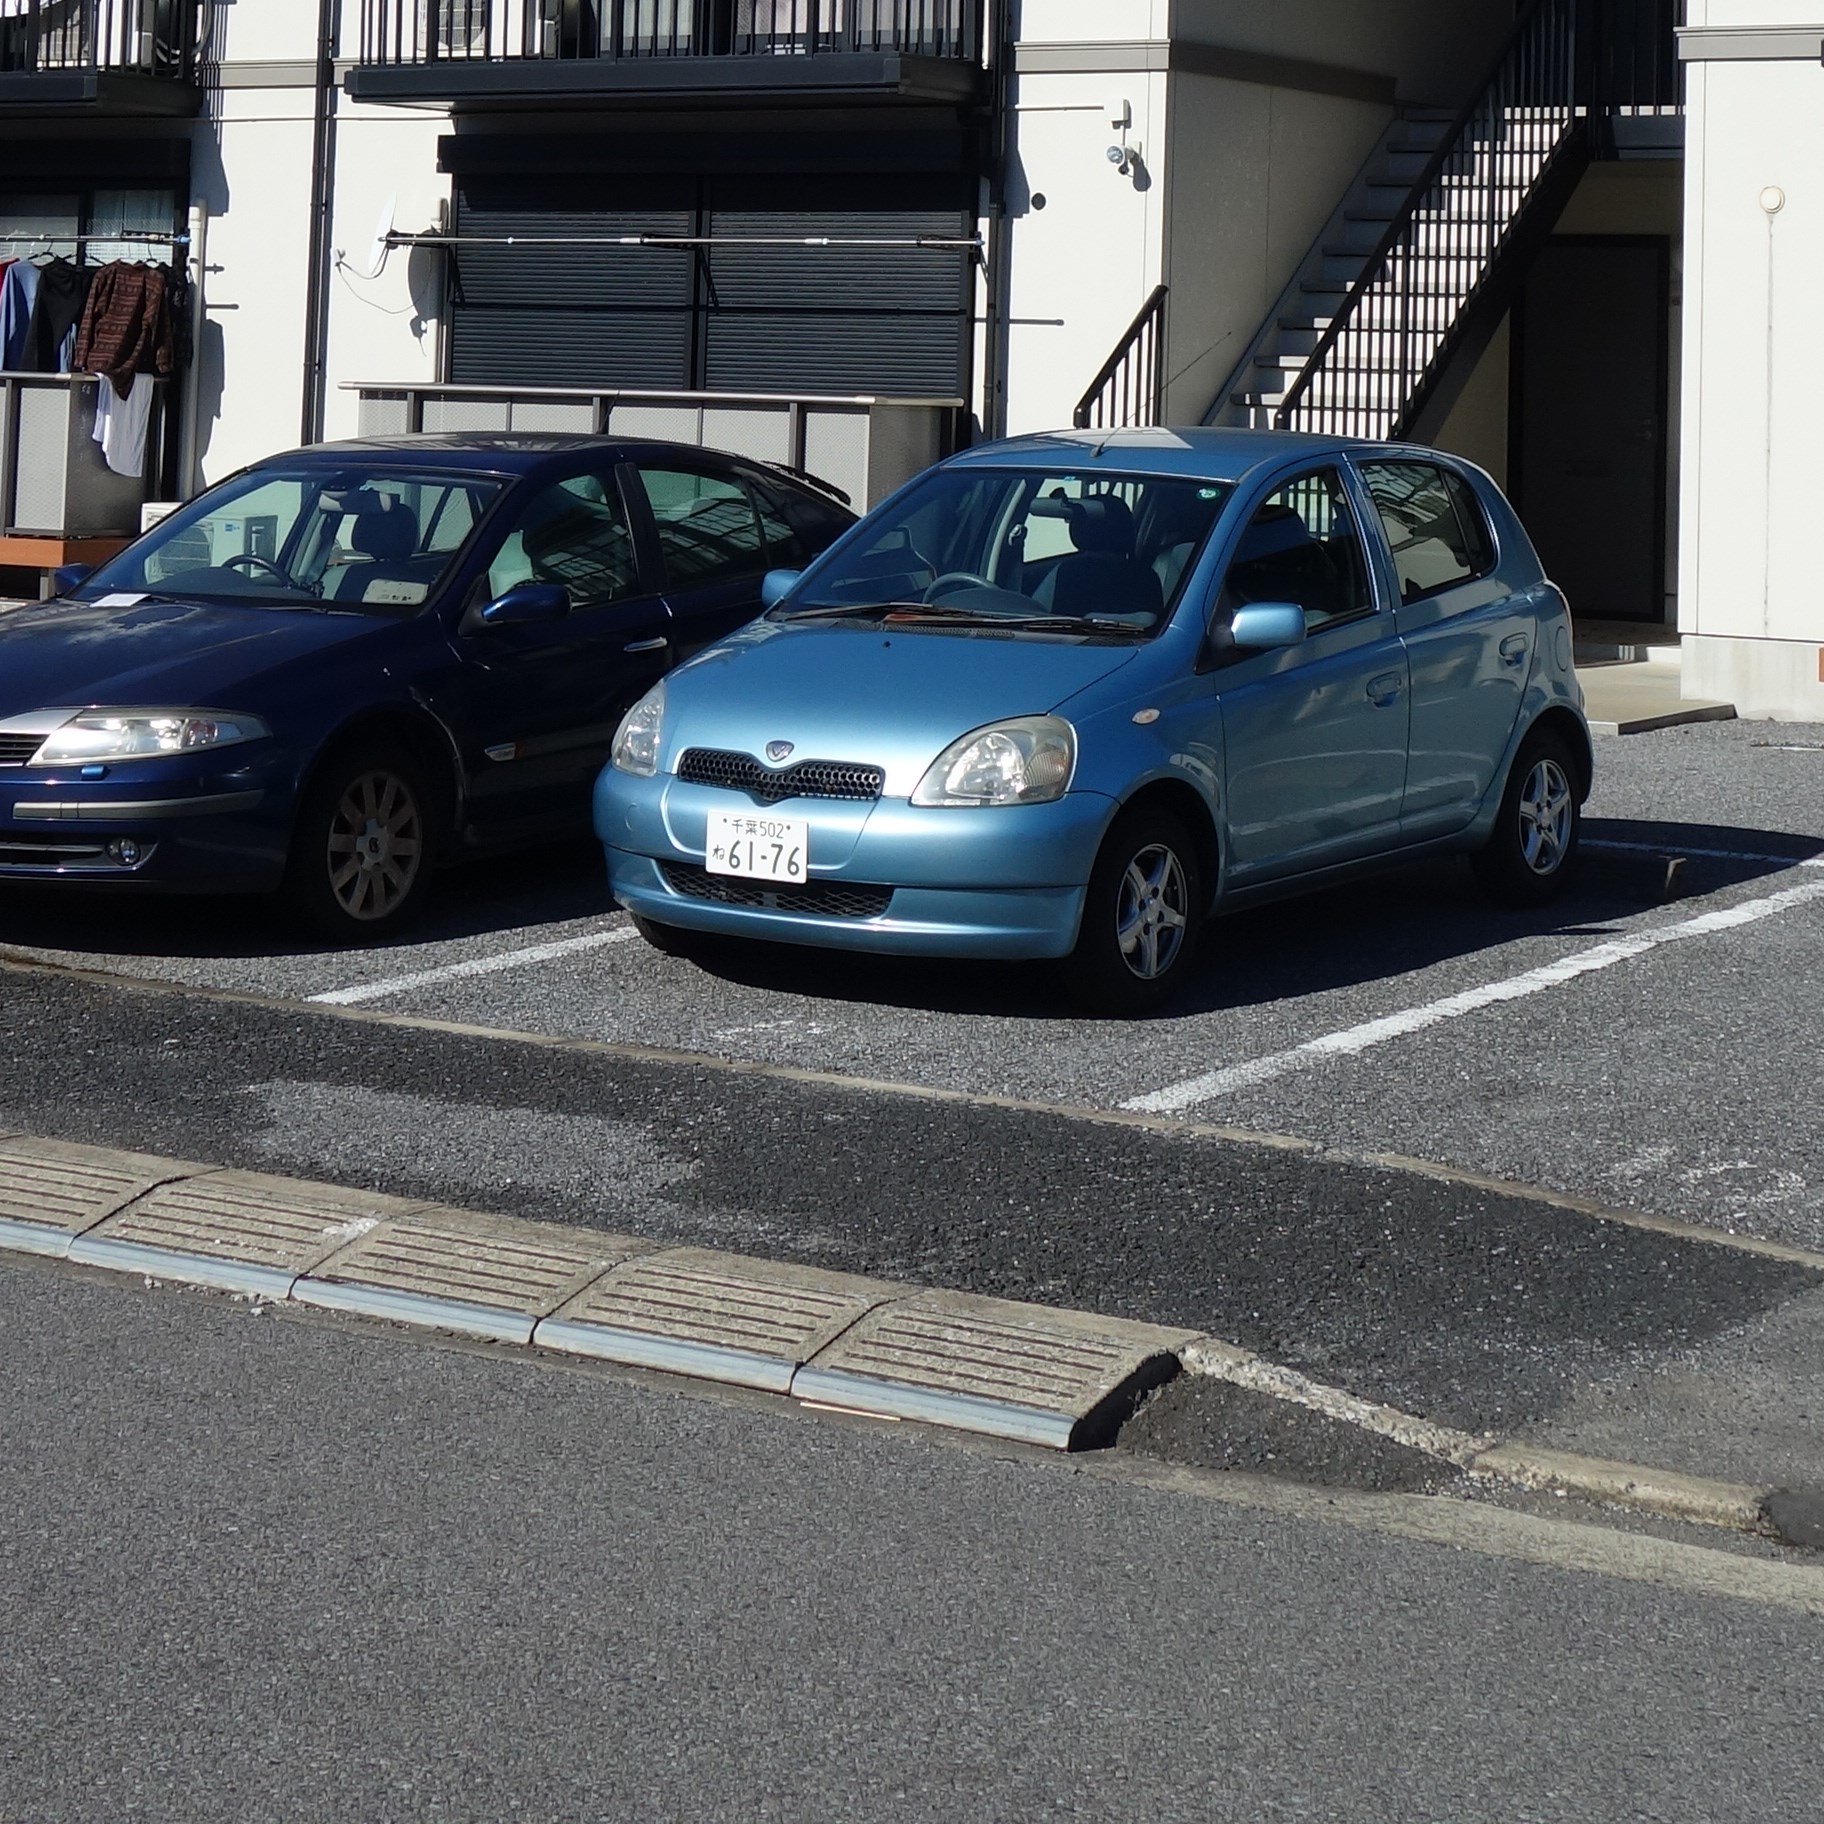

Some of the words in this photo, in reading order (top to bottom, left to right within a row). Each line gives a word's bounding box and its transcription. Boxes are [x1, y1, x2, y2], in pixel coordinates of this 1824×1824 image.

[731, 818, 784, 839] 千葉502
[712, 844, 725, 860] ね
[728, 839, 800, 876] 61-76
